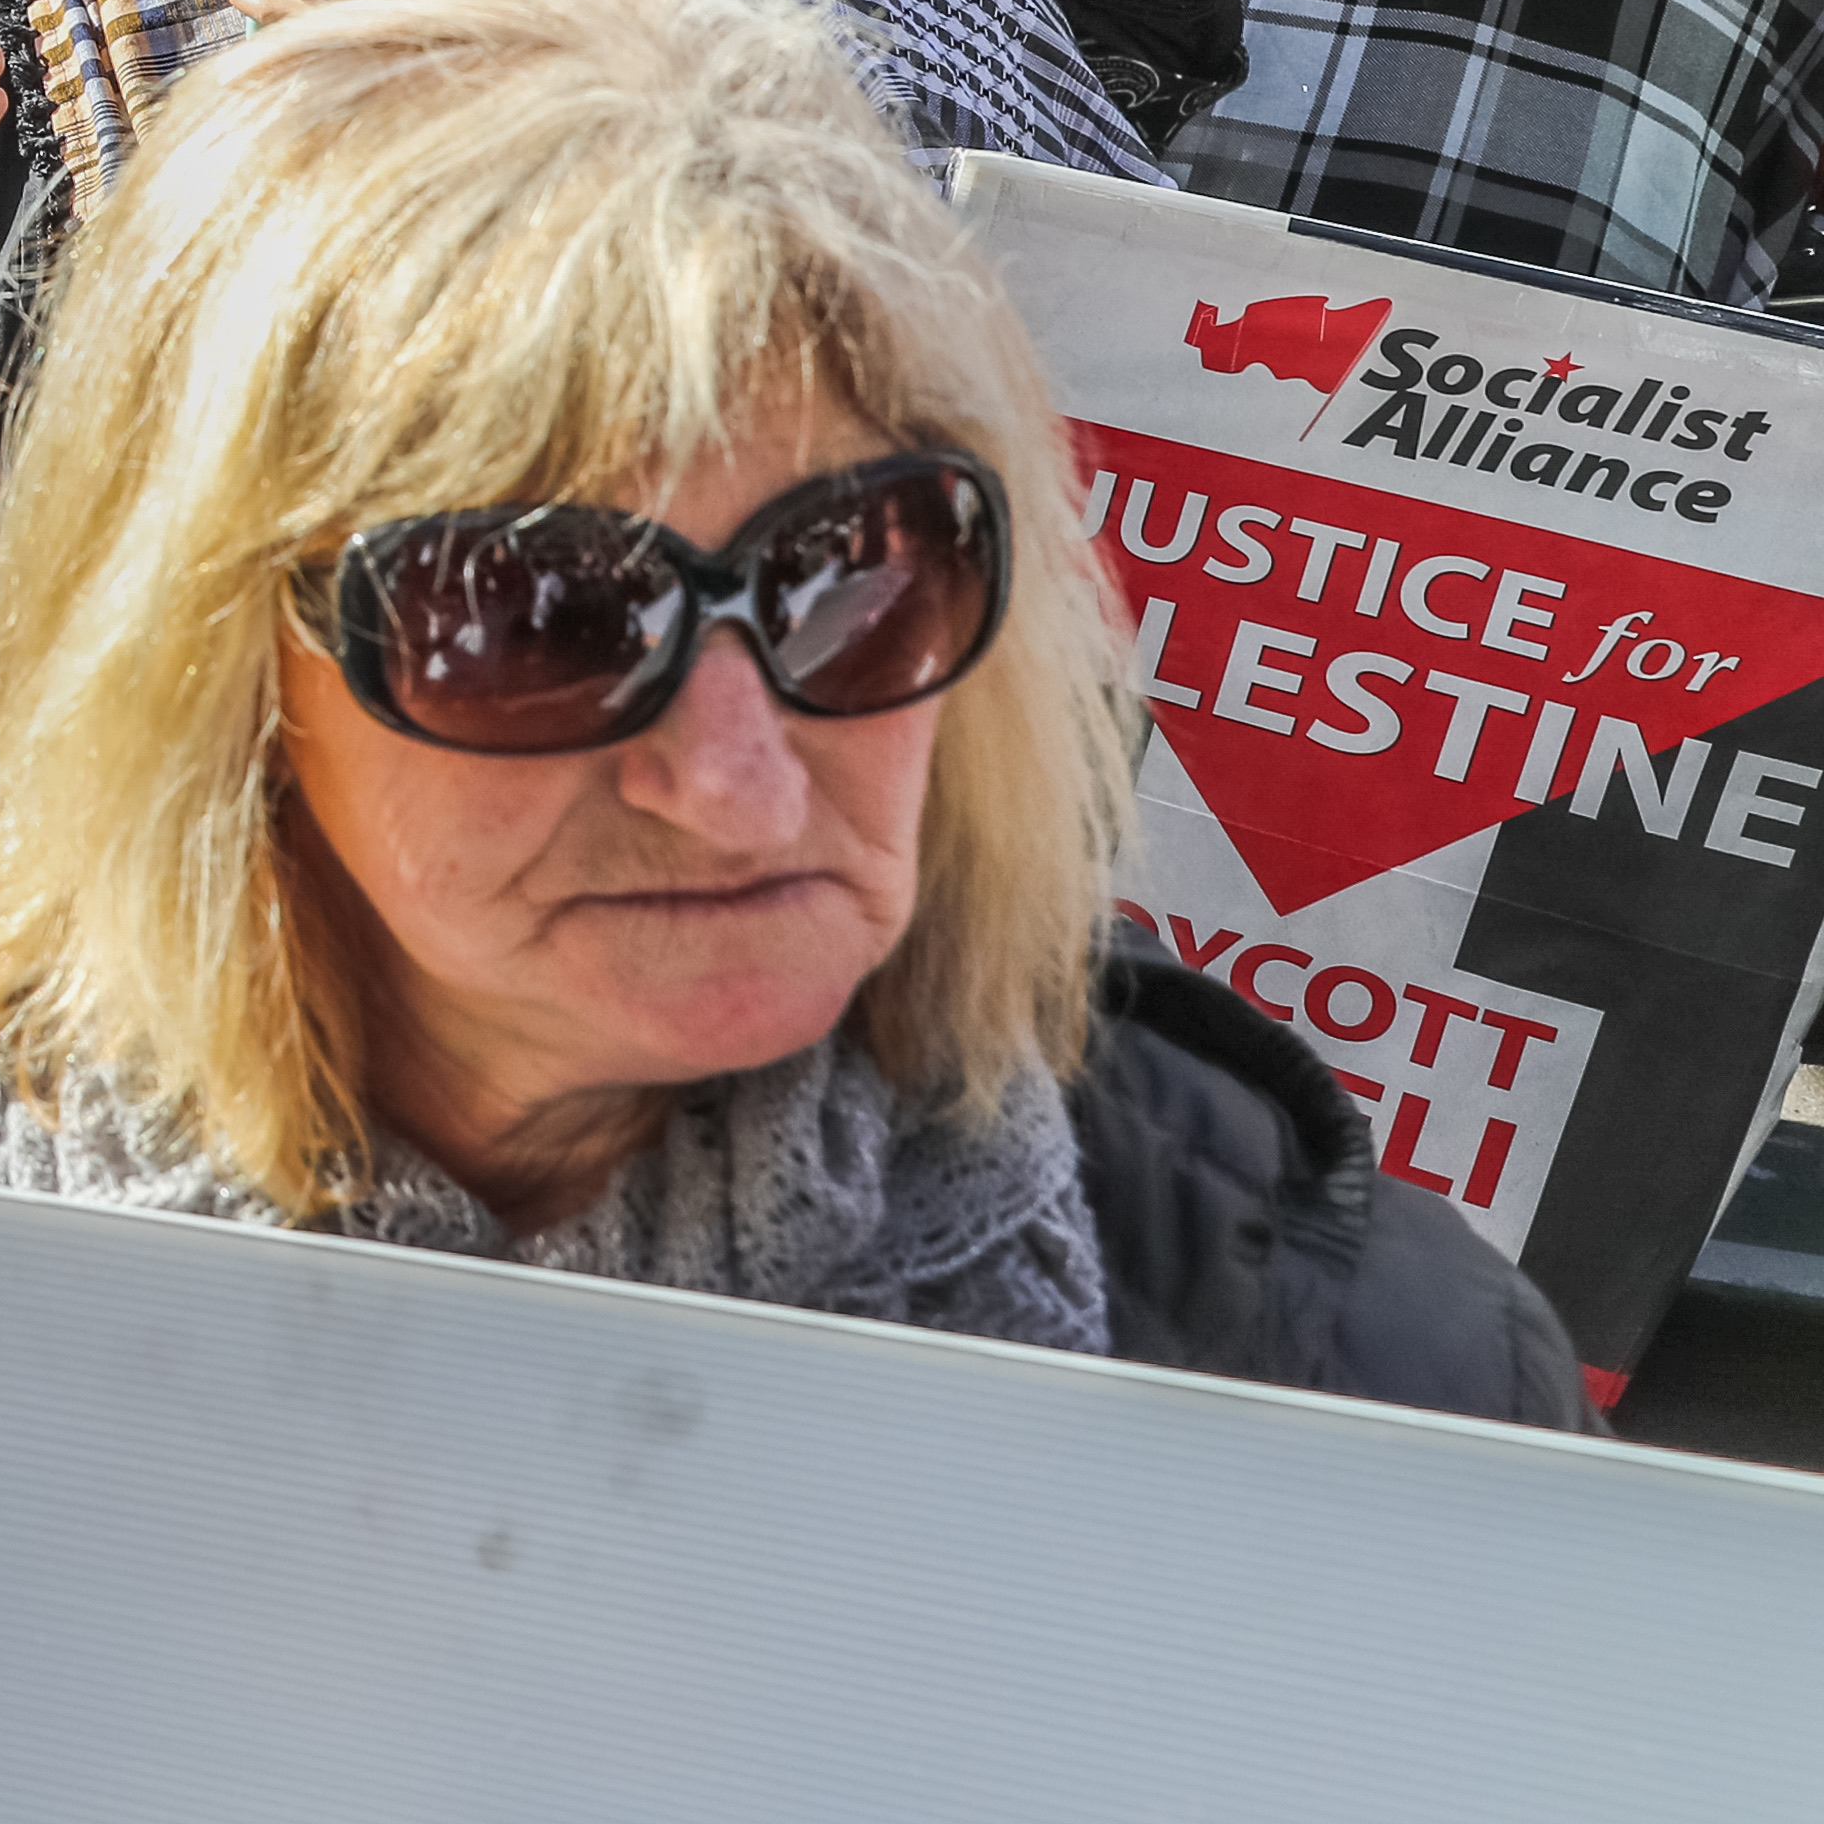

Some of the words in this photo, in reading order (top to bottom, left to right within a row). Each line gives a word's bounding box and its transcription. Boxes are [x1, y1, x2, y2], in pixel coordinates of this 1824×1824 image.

[1341, 389, 1735, 525] Alliance
[1358, 328, 1772, 463] Socialist
[1562, 608, 1742, 694] for
[1138, 595, 1824, 870] LESTINE
[1114, 897, 1560, 1093] YCOTT
